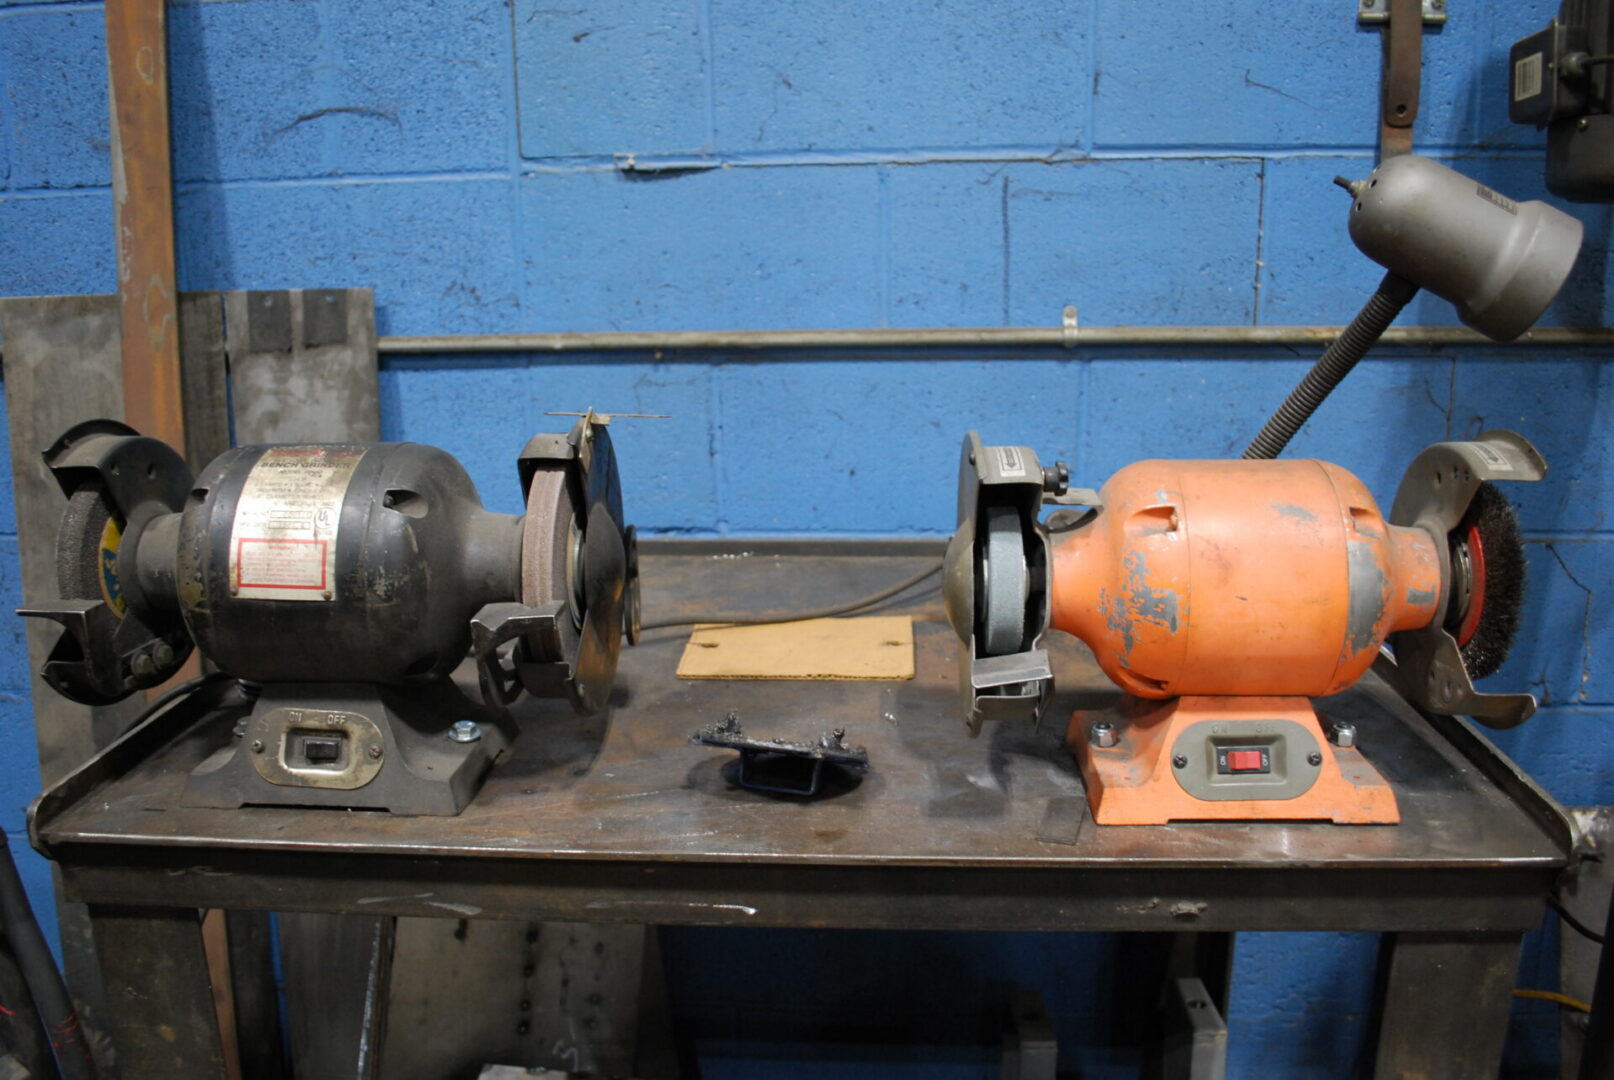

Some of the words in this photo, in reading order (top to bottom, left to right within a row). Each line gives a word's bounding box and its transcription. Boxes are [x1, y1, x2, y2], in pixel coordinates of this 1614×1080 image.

[288, 711, 303, 722] ON
[327, 714, 347, 725] OFF
[1220, 755, 1226, 765] ON
